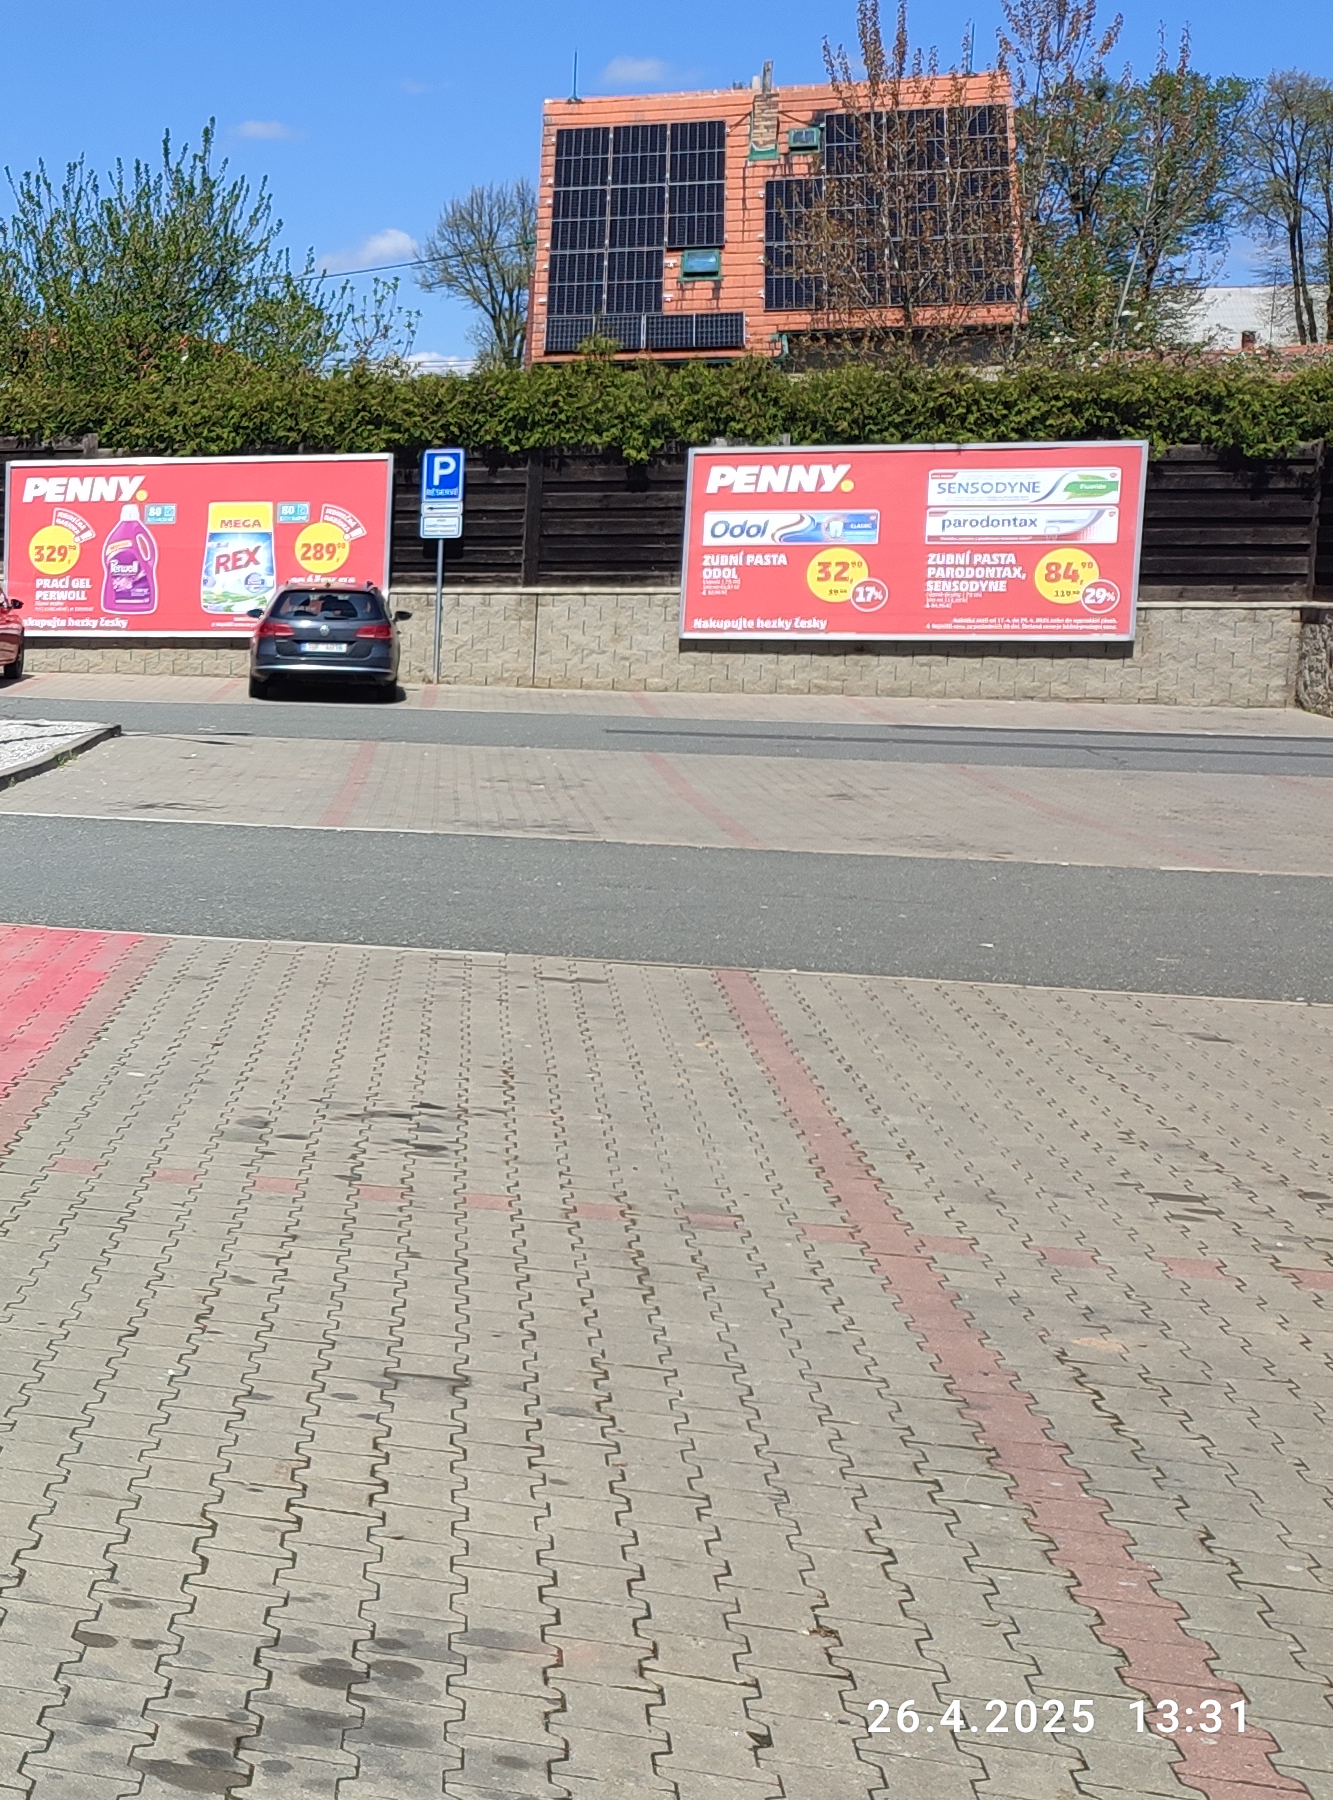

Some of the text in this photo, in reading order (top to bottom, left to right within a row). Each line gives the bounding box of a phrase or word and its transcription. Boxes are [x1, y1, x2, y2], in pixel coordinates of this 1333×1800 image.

[433, 456, 456, 486] P
[937, 481, 1041, 494] SENSODYNE
[710, 519, 769, 539] Odol
[941, 516, 1037, 532] parodontax
[215, 545, 261, 575] REX
[702, 551, 787, 566] ZUBNÍ PASTA
[927, 550, 1016, 565] ZUBNÍ PASTA
[702, 568, 738, 579] ODOL
[35, 576, 92, 588] PRACÍ GEL
[926, 580, 1007, 592] SENSODYNE
[35, 590, 87, 600] PERWOLL
[855, 586, 883, 603] 17%
[1085, 587, 1115, 604] 29%
[693, 617, 827, 630] Nakupujte hezky česky
